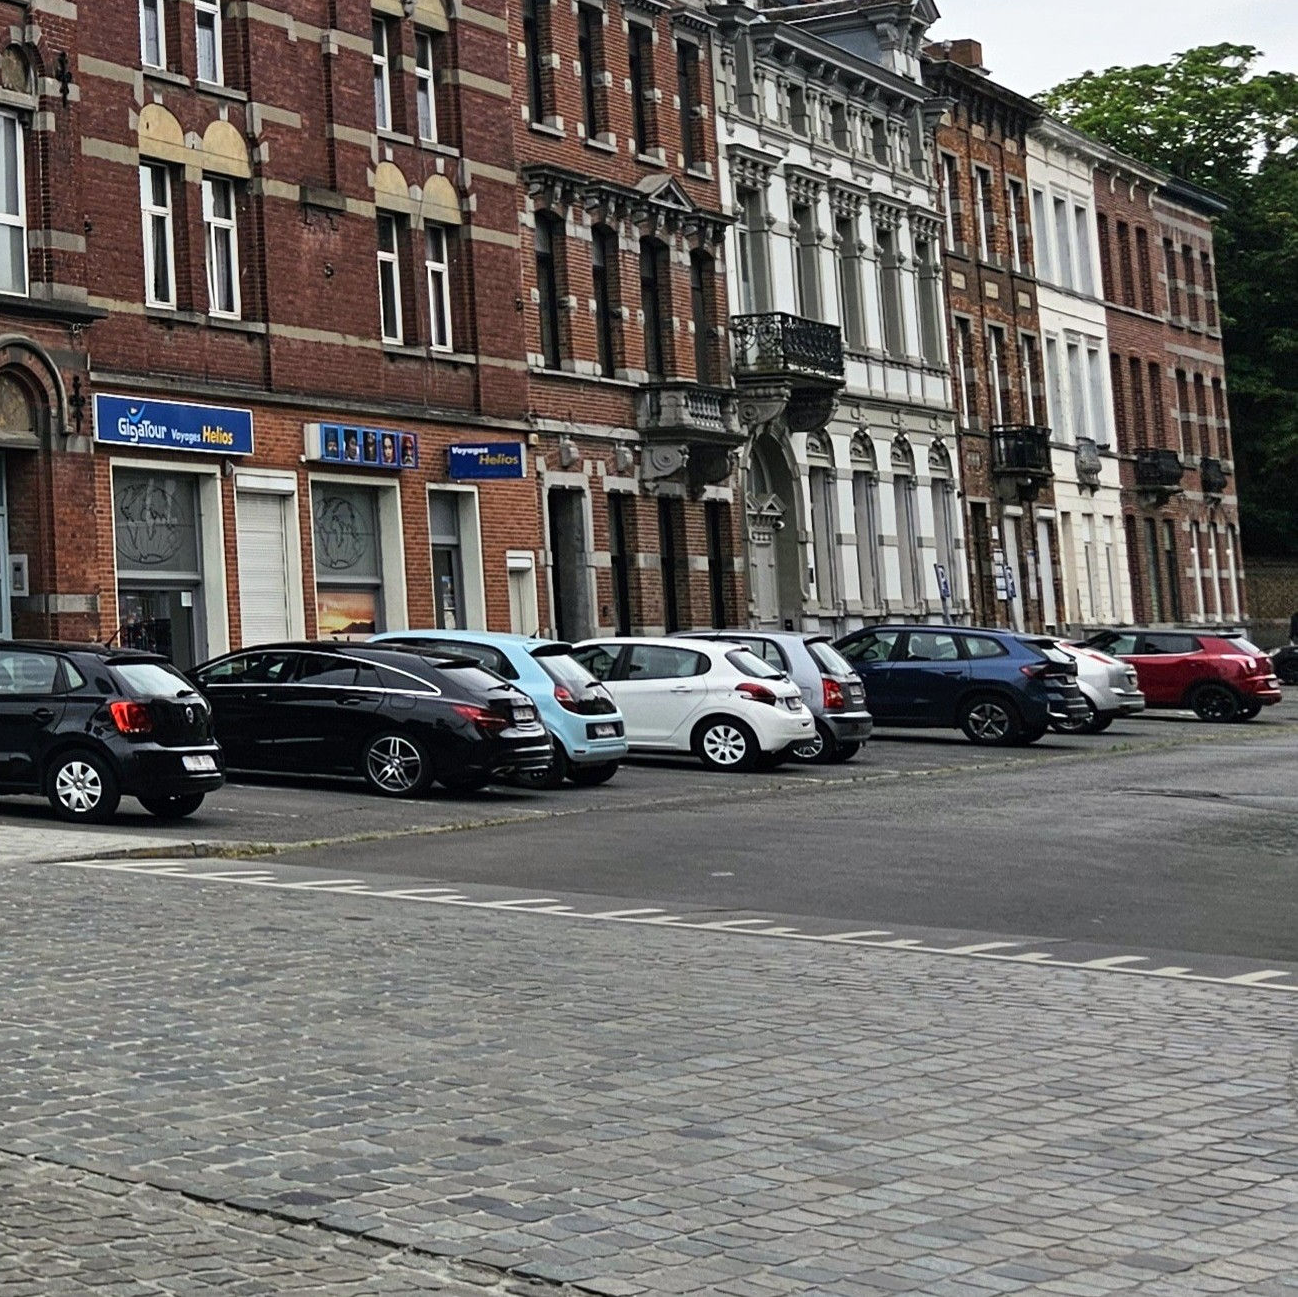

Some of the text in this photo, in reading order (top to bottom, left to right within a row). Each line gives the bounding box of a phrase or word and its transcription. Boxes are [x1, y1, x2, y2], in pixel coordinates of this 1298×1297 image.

[171, 428, 201, 444] Voyages
[202, 425, 233, 445] Helios
[451, 446, 488, 456] Voyages
[478, 453, 519, 465] Helios
